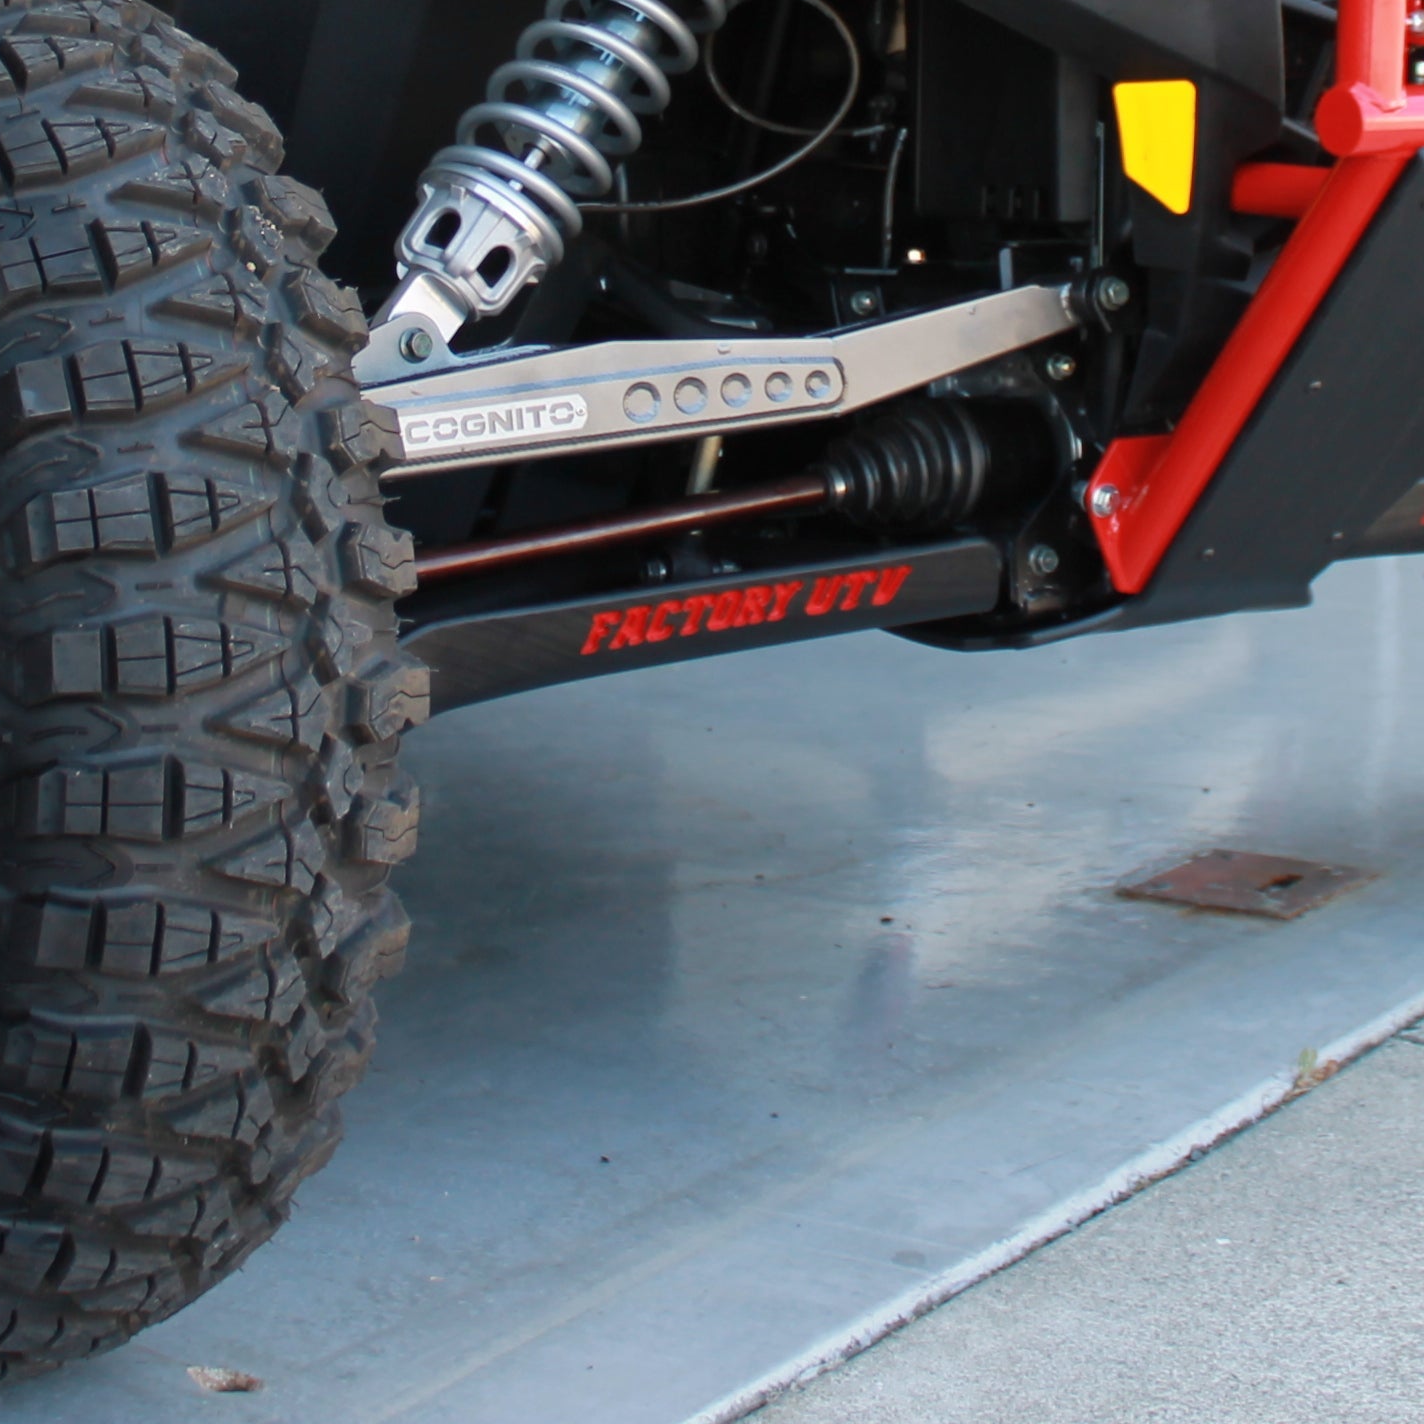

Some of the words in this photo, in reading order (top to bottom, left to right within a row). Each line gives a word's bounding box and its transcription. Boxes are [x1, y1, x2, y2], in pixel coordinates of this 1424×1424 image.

[404, 400, 575, 444] COGNITO
[579, 579, 805, 656] FACTORY
[804, 564, 913, 617] UTV
